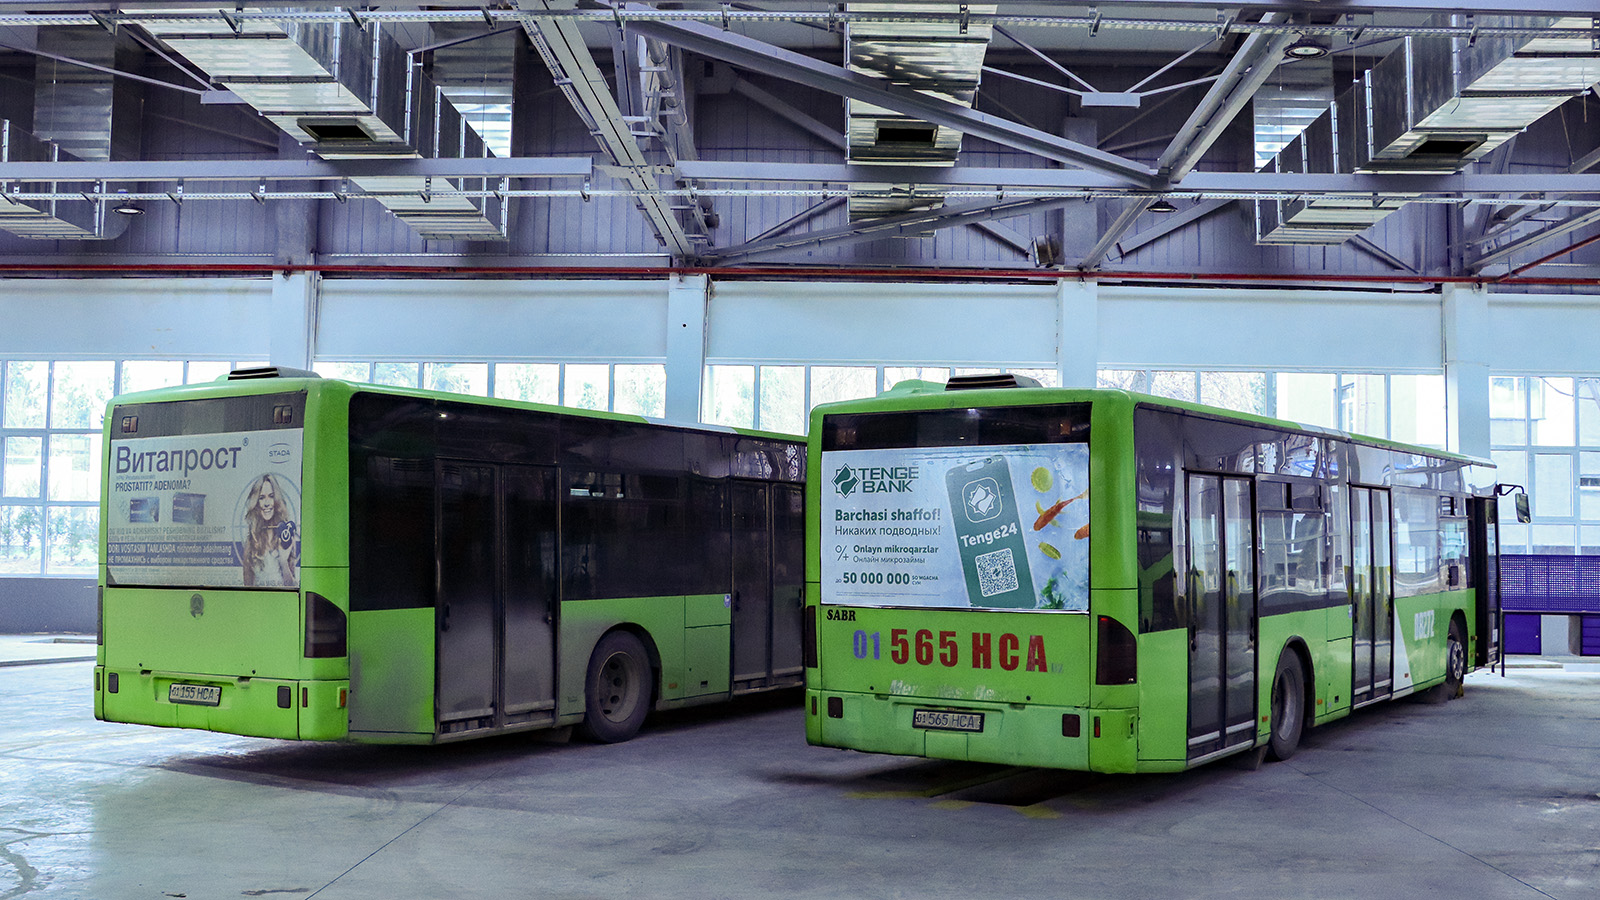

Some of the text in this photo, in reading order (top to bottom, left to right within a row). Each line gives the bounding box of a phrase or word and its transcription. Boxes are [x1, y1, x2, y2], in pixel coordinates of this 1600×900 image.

[268, 449, 291, 458] STADA
[858, 467, 919, 480] TENGE
[115, 480, 191, 492] PROSTATIT? ADENOMA?
[862, 480, 914, 493] BANK
[835, 508, 941, 521] Barchasi shaffof!
[835, 525, 941, 537] Никаких подводных!
[960, 522, 1018, 548] Tenge24
[853, 544, 939, 555] Onlayn mikroqarzlar
[853, 555, 925, 565] Онлайн микрозаймы
[843, 572, 857, 584] 50
[860, 572, 883, 584] 000
[886, 572, 910, 585] 000
[826, 609, 856, 622] SABR
[852, 629, 881, 660] 01
[891, 628, 958, 668] 565
[972, 632, 1048, 673] HCA
[180, 686, 196, 699] 155
[197, 687, 214, 700] HCA
[917, 713, 974, 728] 01 565 HCA
